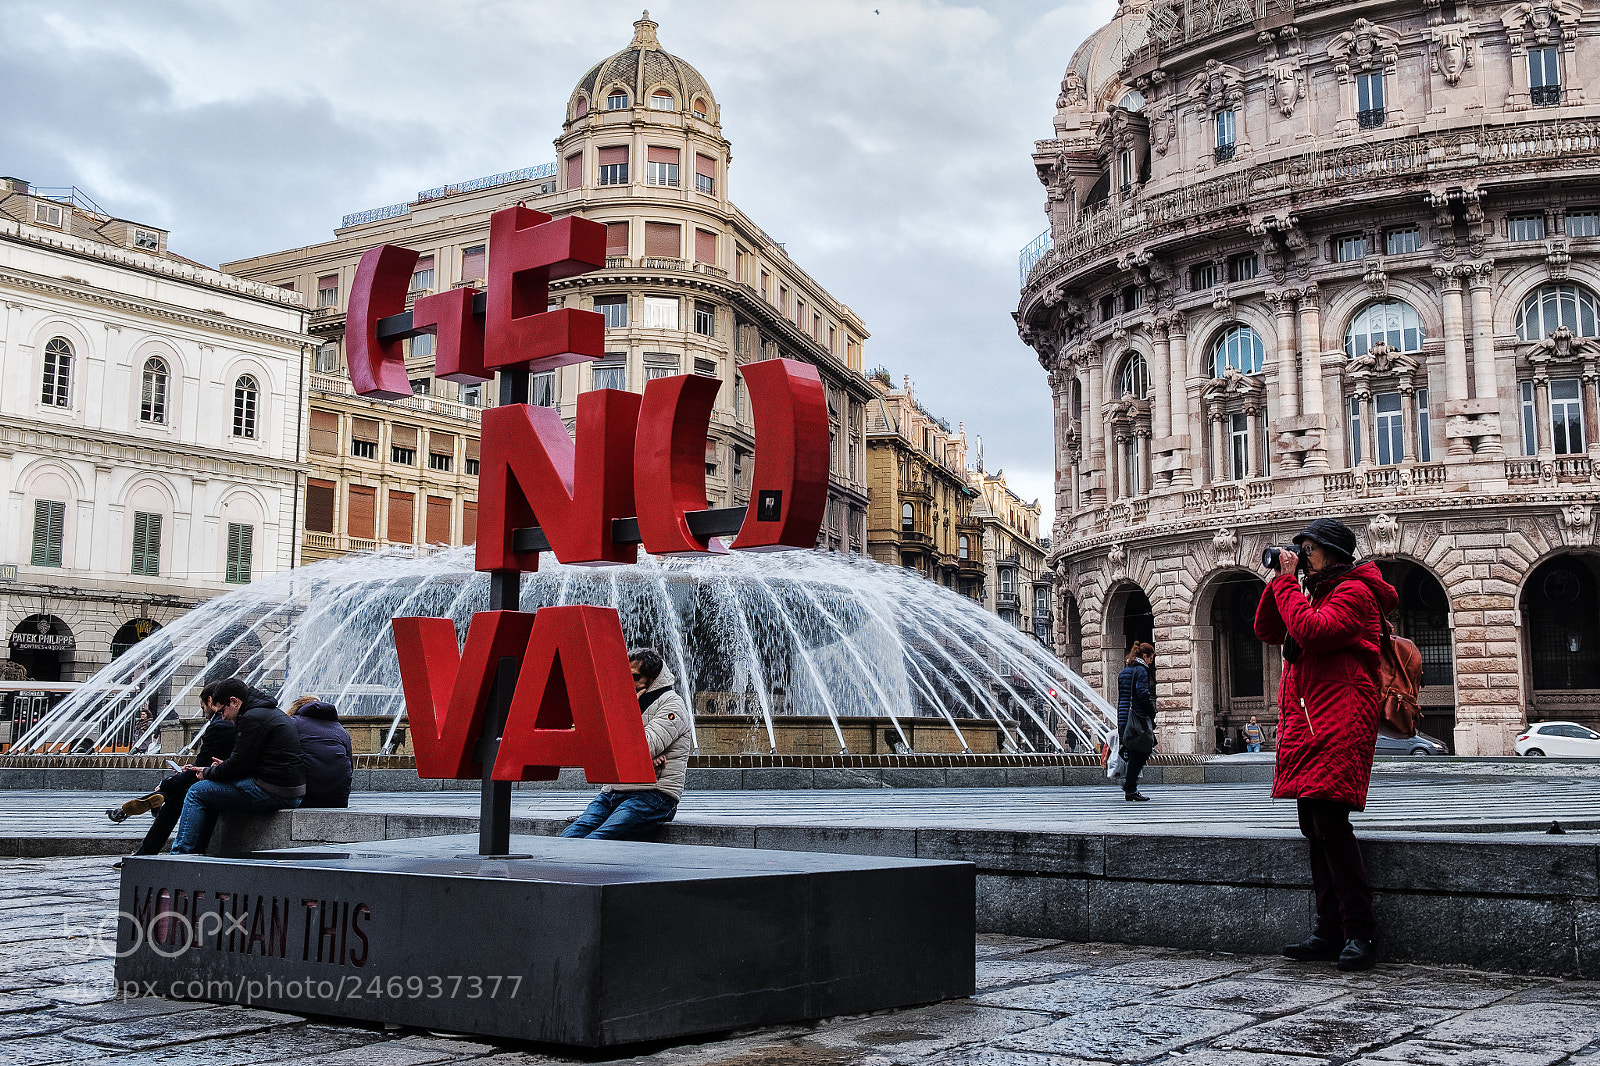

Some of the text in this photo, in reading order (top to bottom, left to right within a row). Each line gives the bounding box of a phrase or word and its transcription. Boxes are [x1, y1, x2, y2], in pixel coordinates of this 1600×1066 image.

[13, 633, 74, 645] PATEK PHILIPPE
[392, 605, 657, 784] VA
[131, 885, 370, 968] MORE THAN THIS
